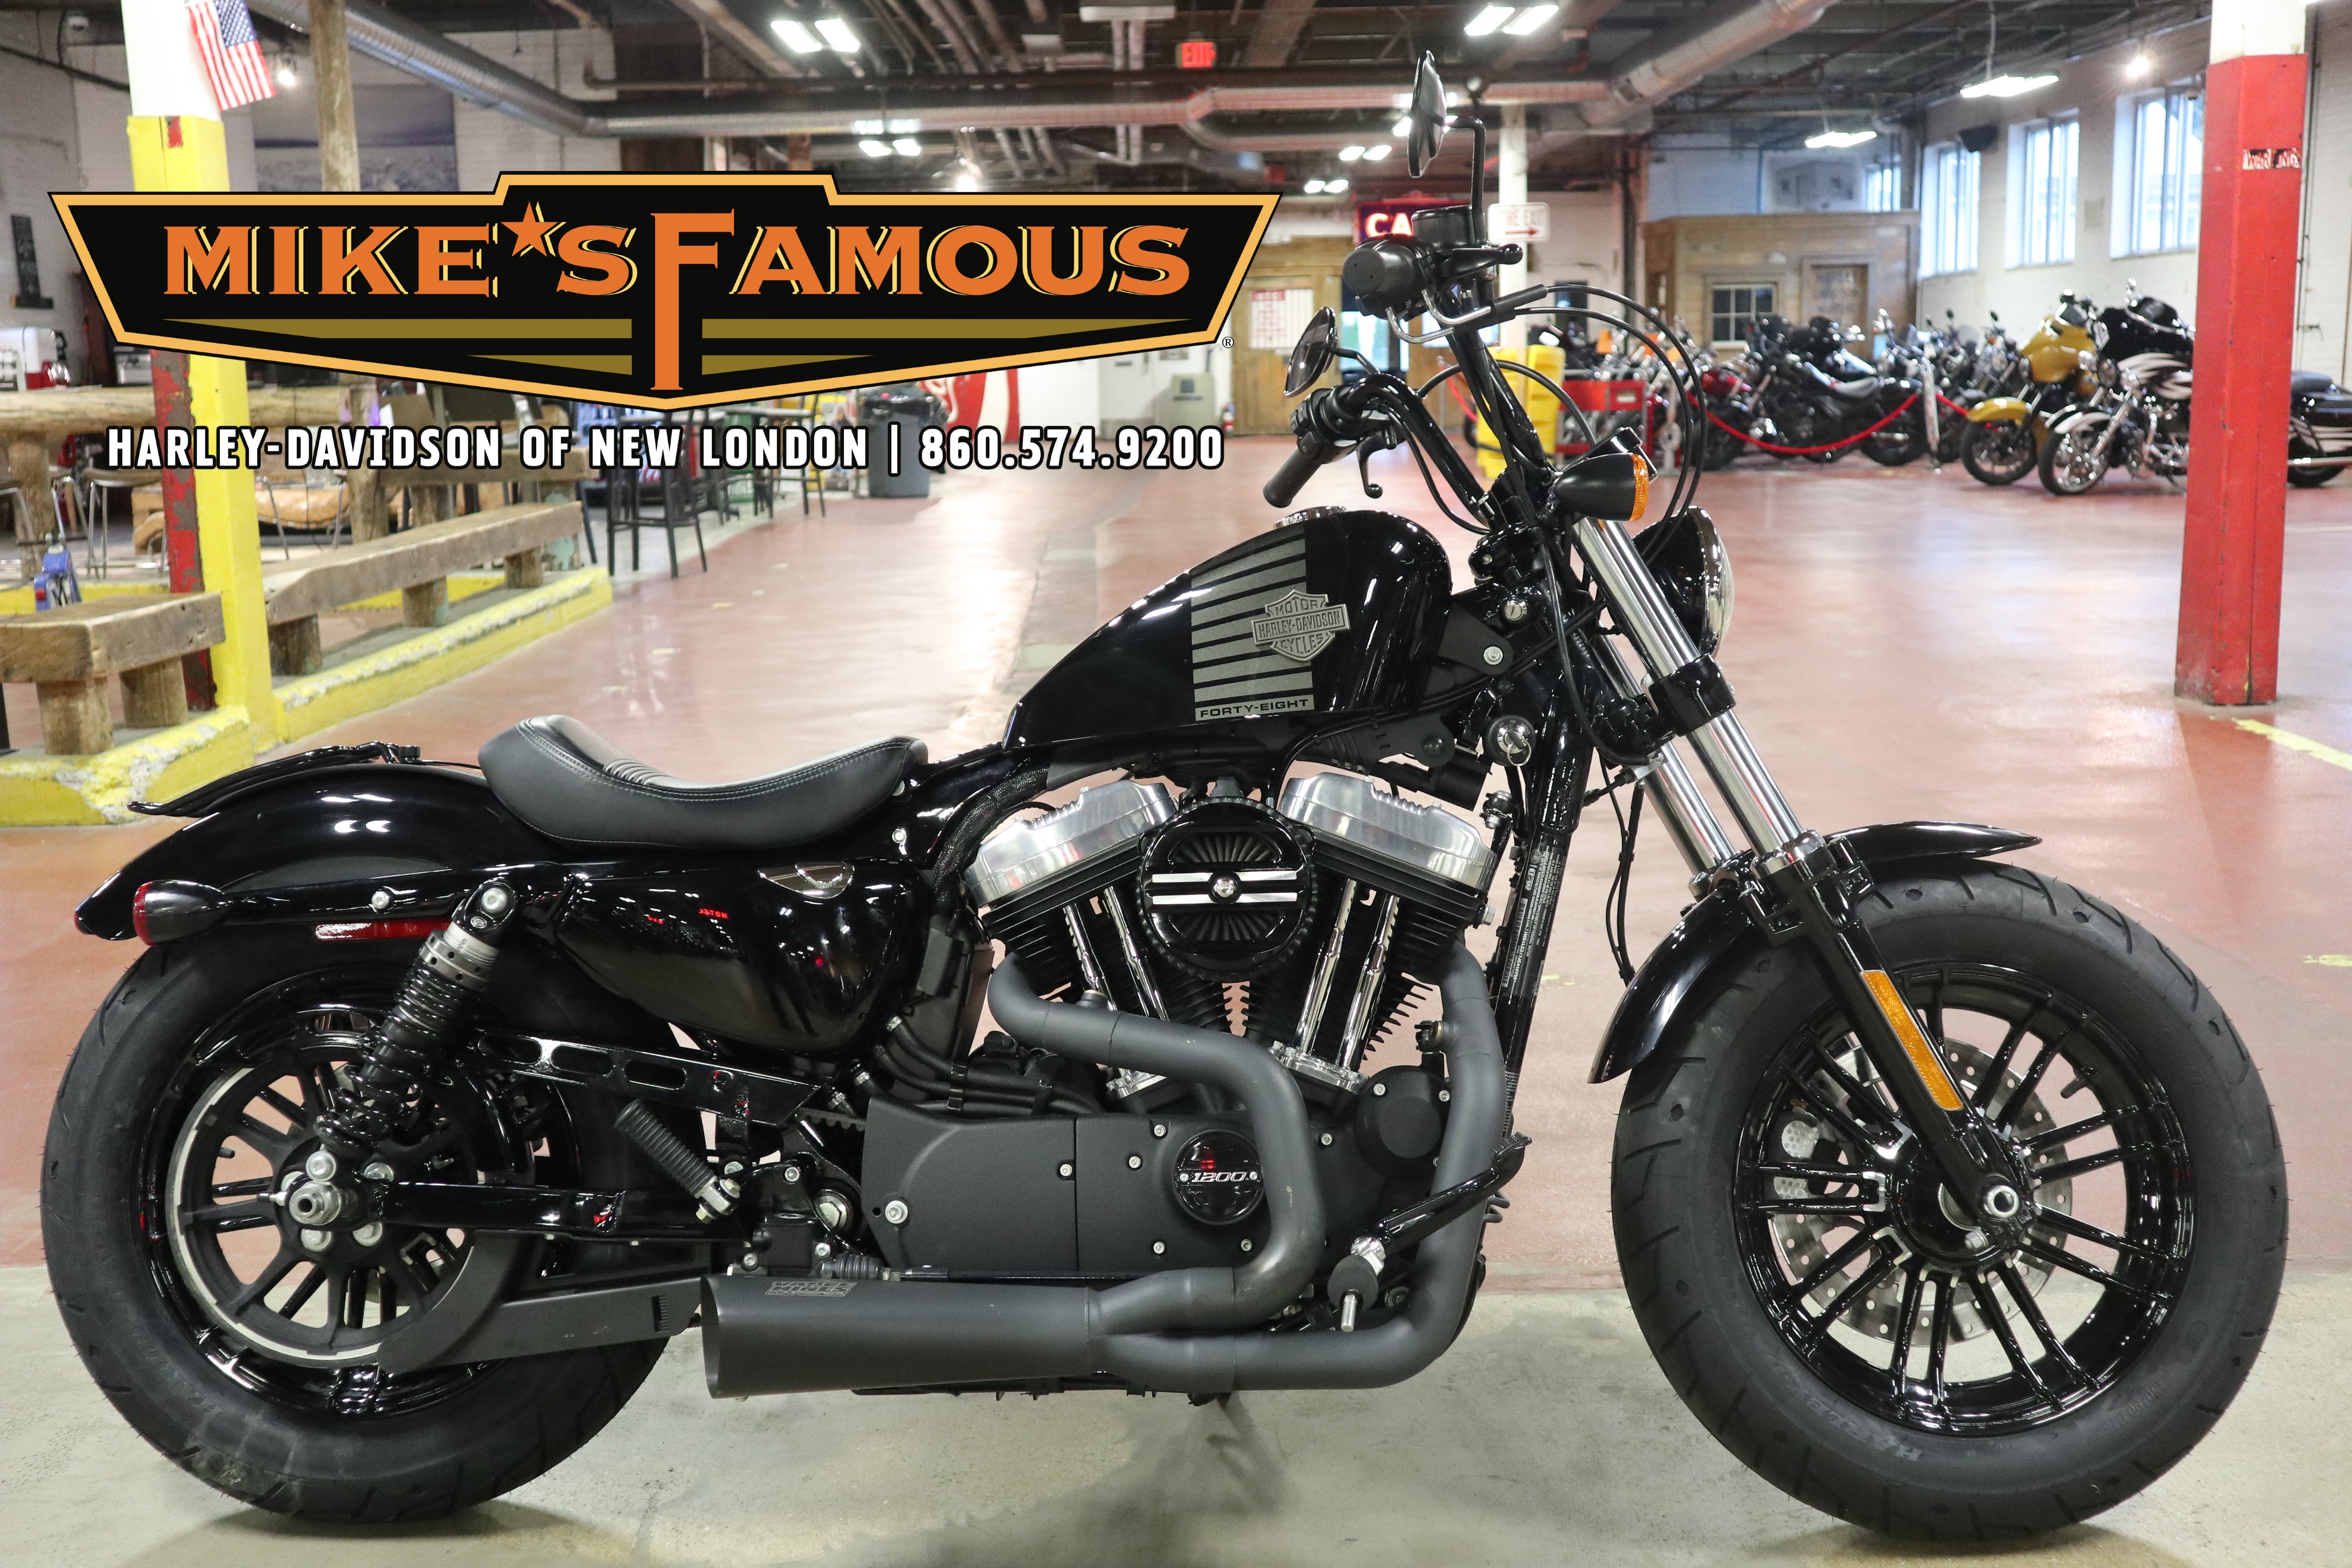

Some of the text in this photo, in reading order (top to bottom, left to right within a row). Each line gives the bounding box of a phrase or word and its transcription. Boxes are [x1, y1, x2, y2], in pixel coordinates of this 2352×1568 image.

[1182, 43, 1213, 67] EXIT
[1276, 597, 1319, 616] MOTOR
[1258, 610, 1340, 638] HARLEY-DAVIDSON
[1279, 633, 1324, 654] CYCLES
[1200, 698, 1309, 718] FORTY-EIGHT
[1533, 871, 1541, 896] MANUFACTURE
[1191, 1171, 1247, 1183] 1200
